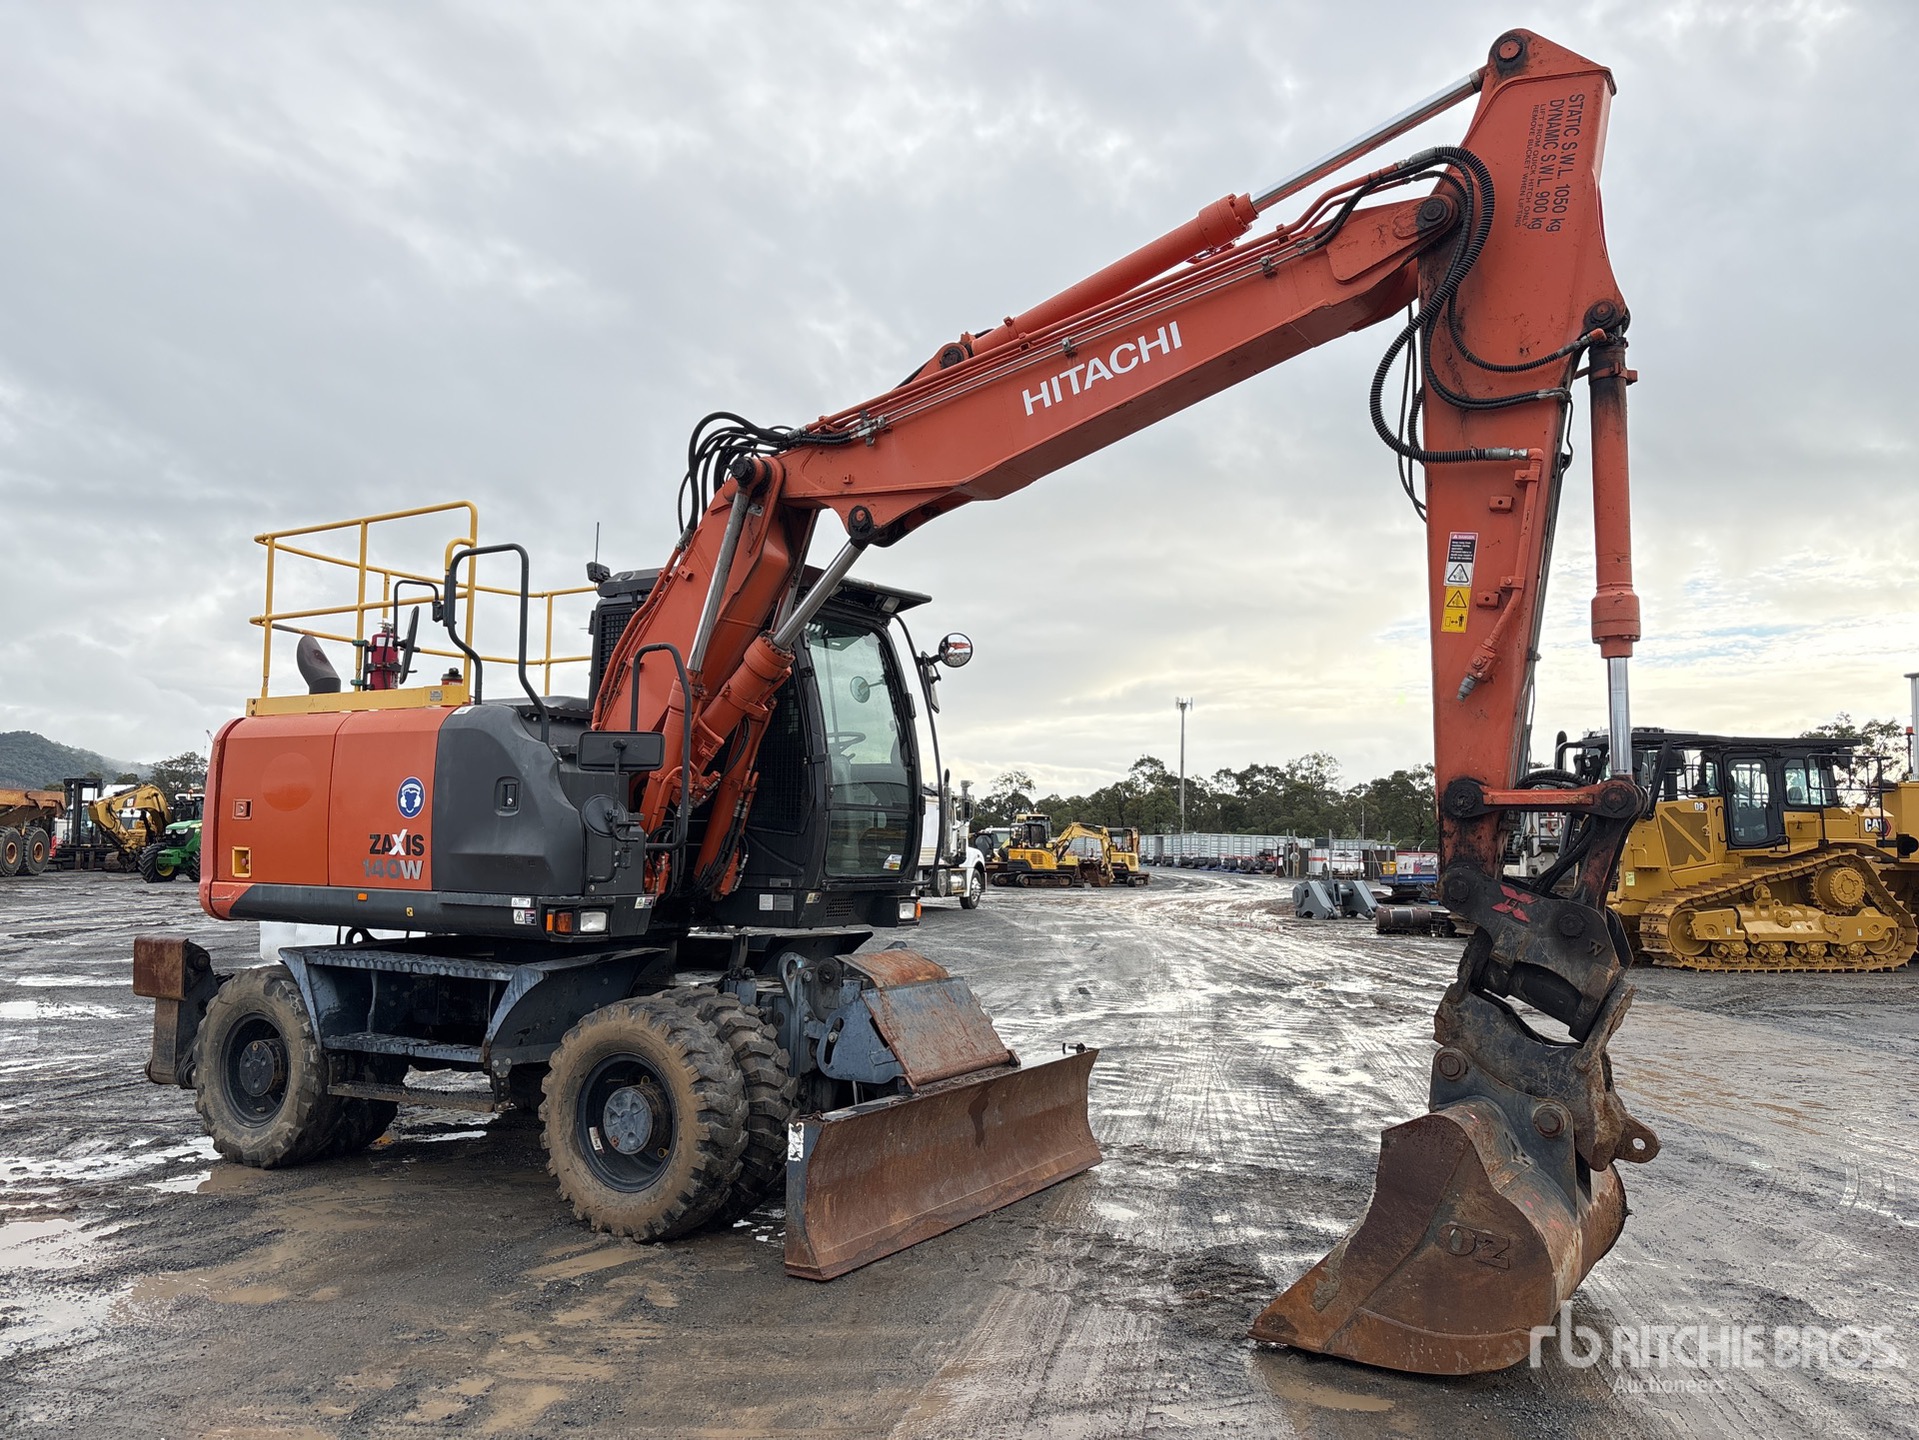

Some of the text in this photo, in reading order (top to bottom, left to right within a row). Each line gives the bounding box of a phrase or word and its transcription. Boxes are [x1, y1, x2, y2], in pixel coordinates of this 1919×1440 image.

[1535, 123, 1544, 147] FROM
[1514, 104, 1540, 228] REMOVE BUCKET WHEN LIFTING
[1527, 99, 1565, 229] DYNAMIC S.W.L. 900 kg
[1530, 150, 1539, 175] QUICK
[1546, 93, 1585, 232] STATIC S.W.L. 1050 kg
[1526, 179, 1534, 203] HITCH
[1522, 206, 1530, 227] ONLY
[1021, 321, 1183, 417] HITACHI
[369, 829, 425, 856] ZAXIS
[362, 857, 424, 880] 140W
